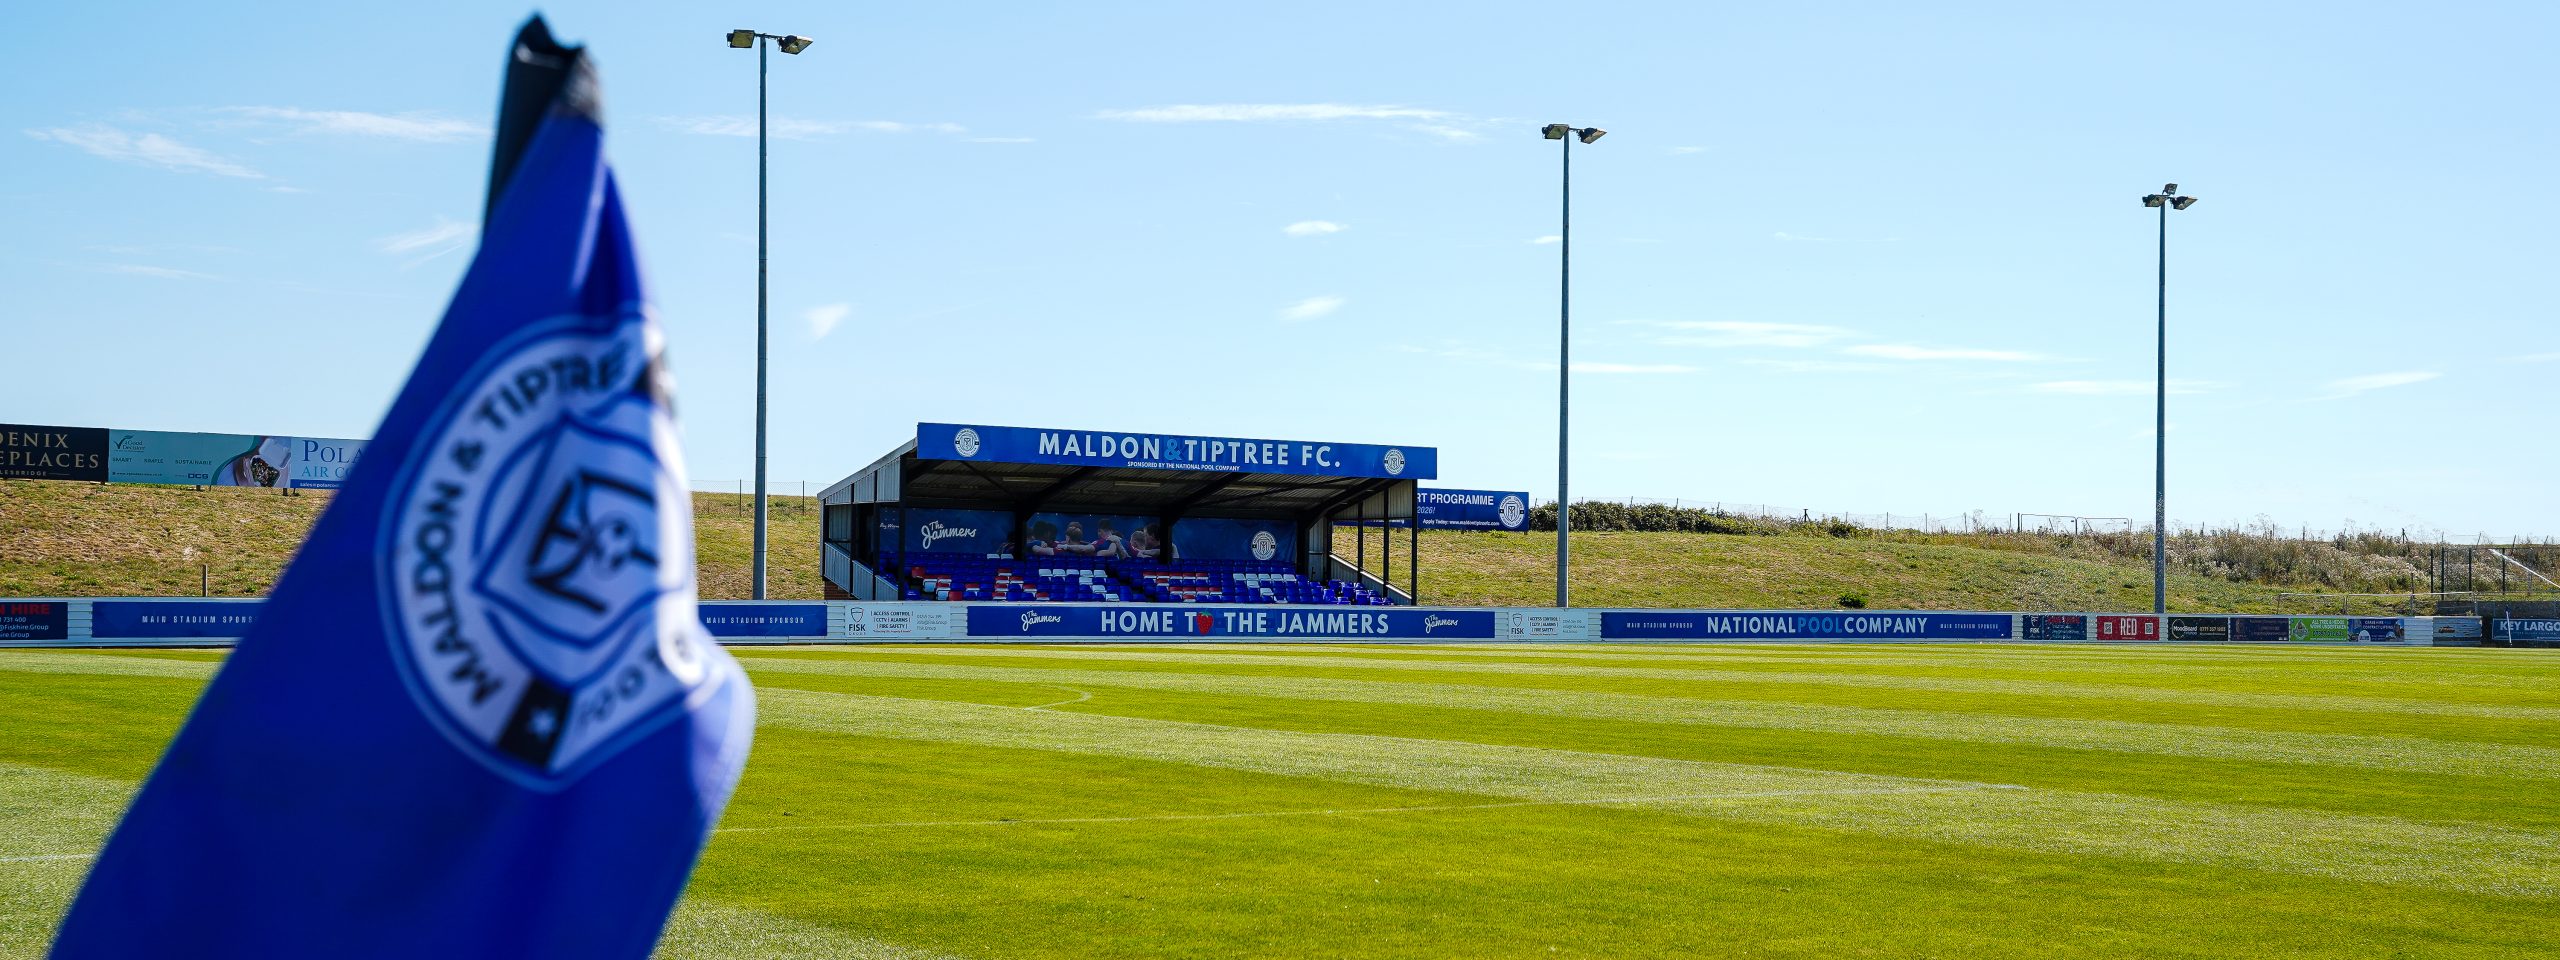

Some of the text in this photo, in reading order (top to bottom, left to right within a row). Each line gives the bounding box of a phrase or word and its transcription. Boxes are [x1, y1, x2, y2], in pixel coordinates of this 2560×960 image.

[0, 431, 69, 448] ENIX
[1302, 445, 1341, 468] FC.
[301, 465, 329, 478] AIR
[1430, 493, 1494, 506] PROGRAMME
[928, 520, 944, 531] The
[921, 525, 977, 550] Jammers
[706, 616, 804, 624] MAIN STADIUM SPONSOR
[1026, 610, 1037, 618] The
[848, 623, 866, 632] FISK
[1021, 614, 1061, 631] Jammers
[1101, 611, 1174, 633] HOME
[1223, 612, 1267, 633] THE
[1276, 613, 1389, 634] JAMMERS
[1424, 618, 1459, 633] Jammers
[2120, 617, 2137, 636] RED
[2500, 621, 2521, 631] KEY
